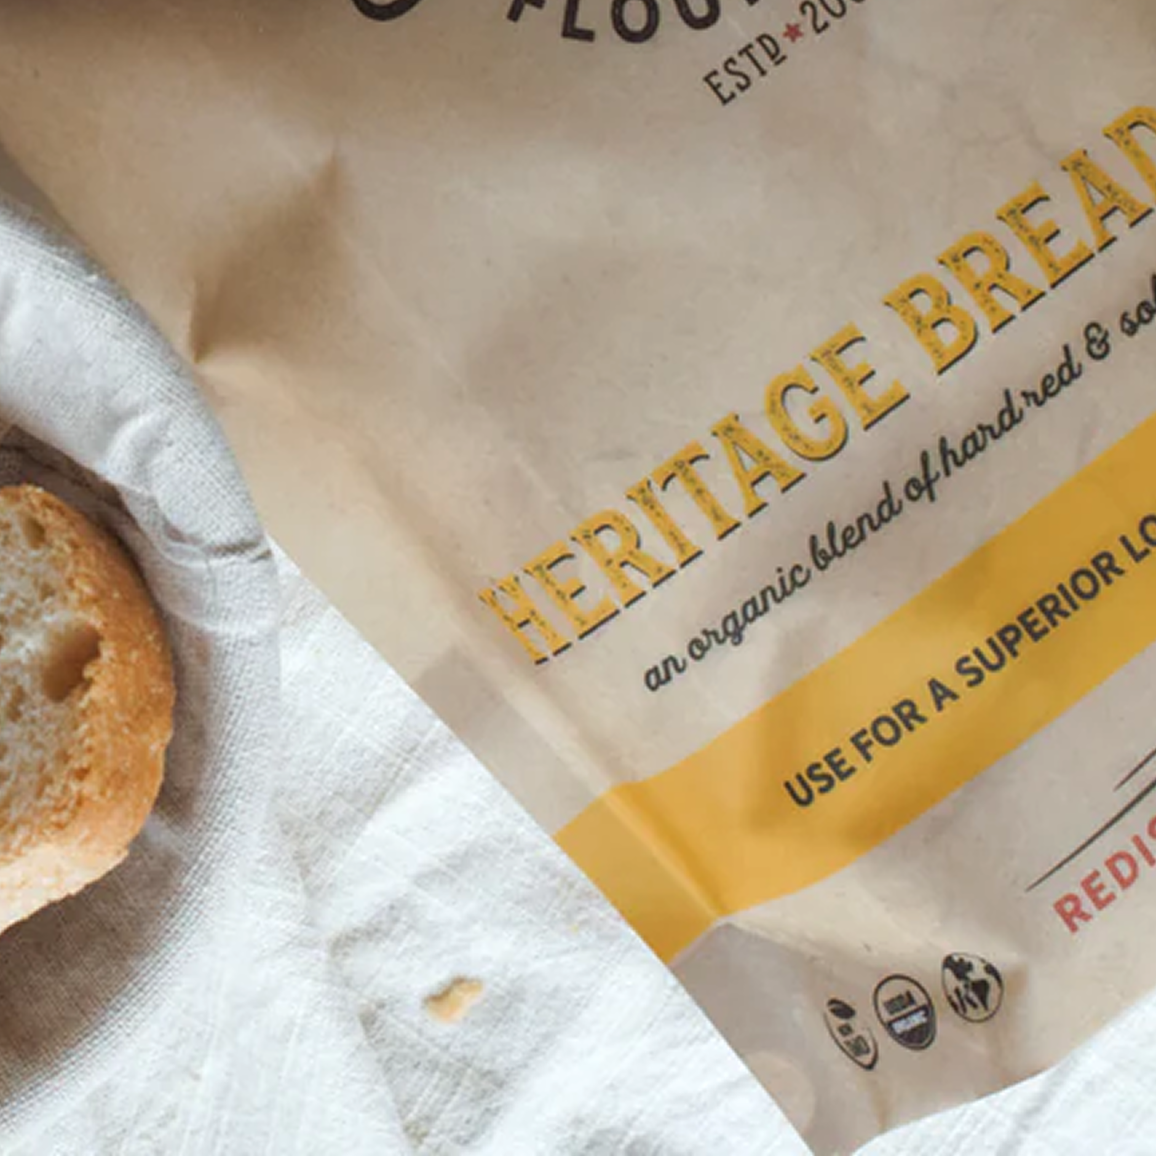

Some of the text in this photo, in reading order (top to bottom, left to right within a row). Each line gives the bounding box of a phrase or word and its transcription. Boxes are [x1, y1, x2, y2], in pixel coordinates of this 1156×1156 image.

[701, 30, 787, 107] ESTD
[478, 320, 911, 666] HERITAGE
[644, 272, 1156, 692] an organic blend of hard red & so
[783, 747, 856, 808] USE
[849, 698, 928, 764] FOR
[927, 677, 960, 712] A
[954, 550, 1126, 688] SUPERIOR
